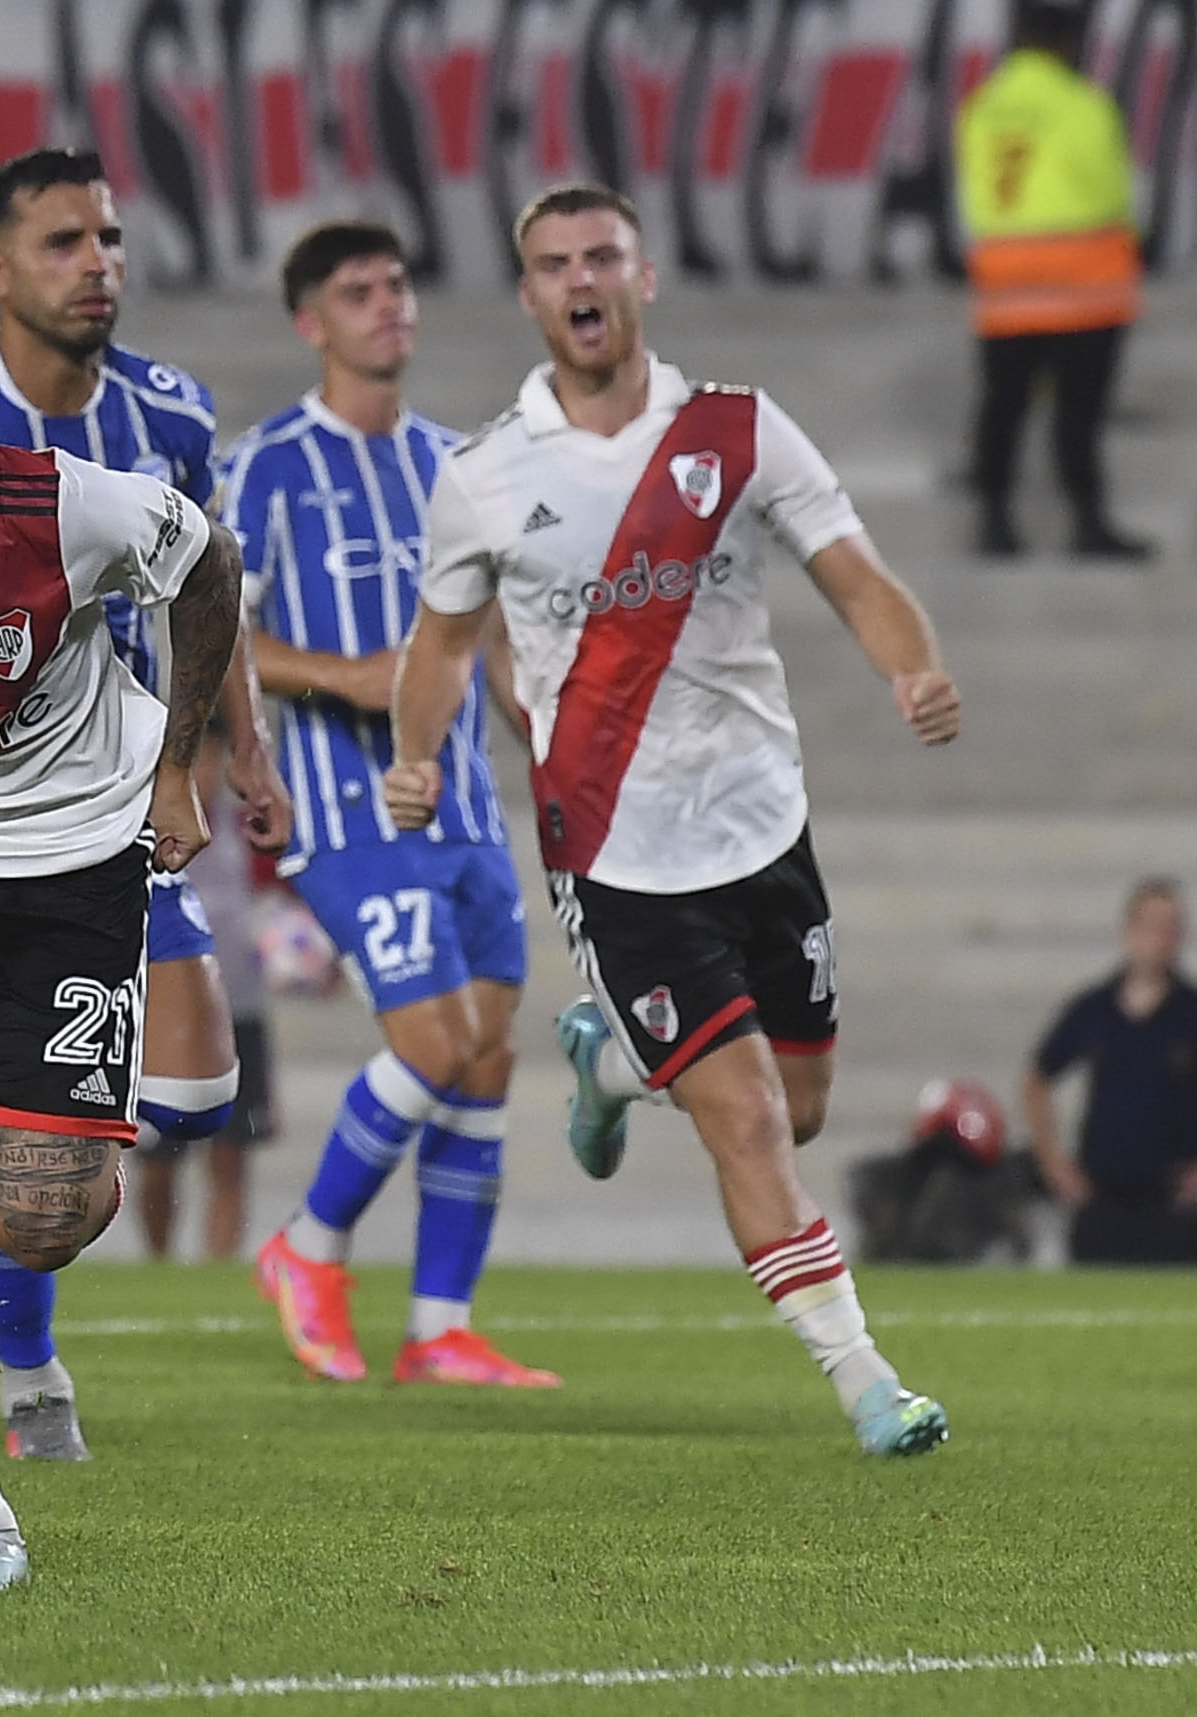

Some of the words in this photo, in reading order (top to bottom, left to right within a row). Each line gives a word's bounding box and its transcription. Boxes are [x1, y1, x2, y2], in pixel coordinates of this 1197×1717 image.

[551, 551, 732, 620] codere
[357, 887, 435, 971] 27
[43, 976, 135, 1066] 21
[70, 1088, 117, 1106] adidas
